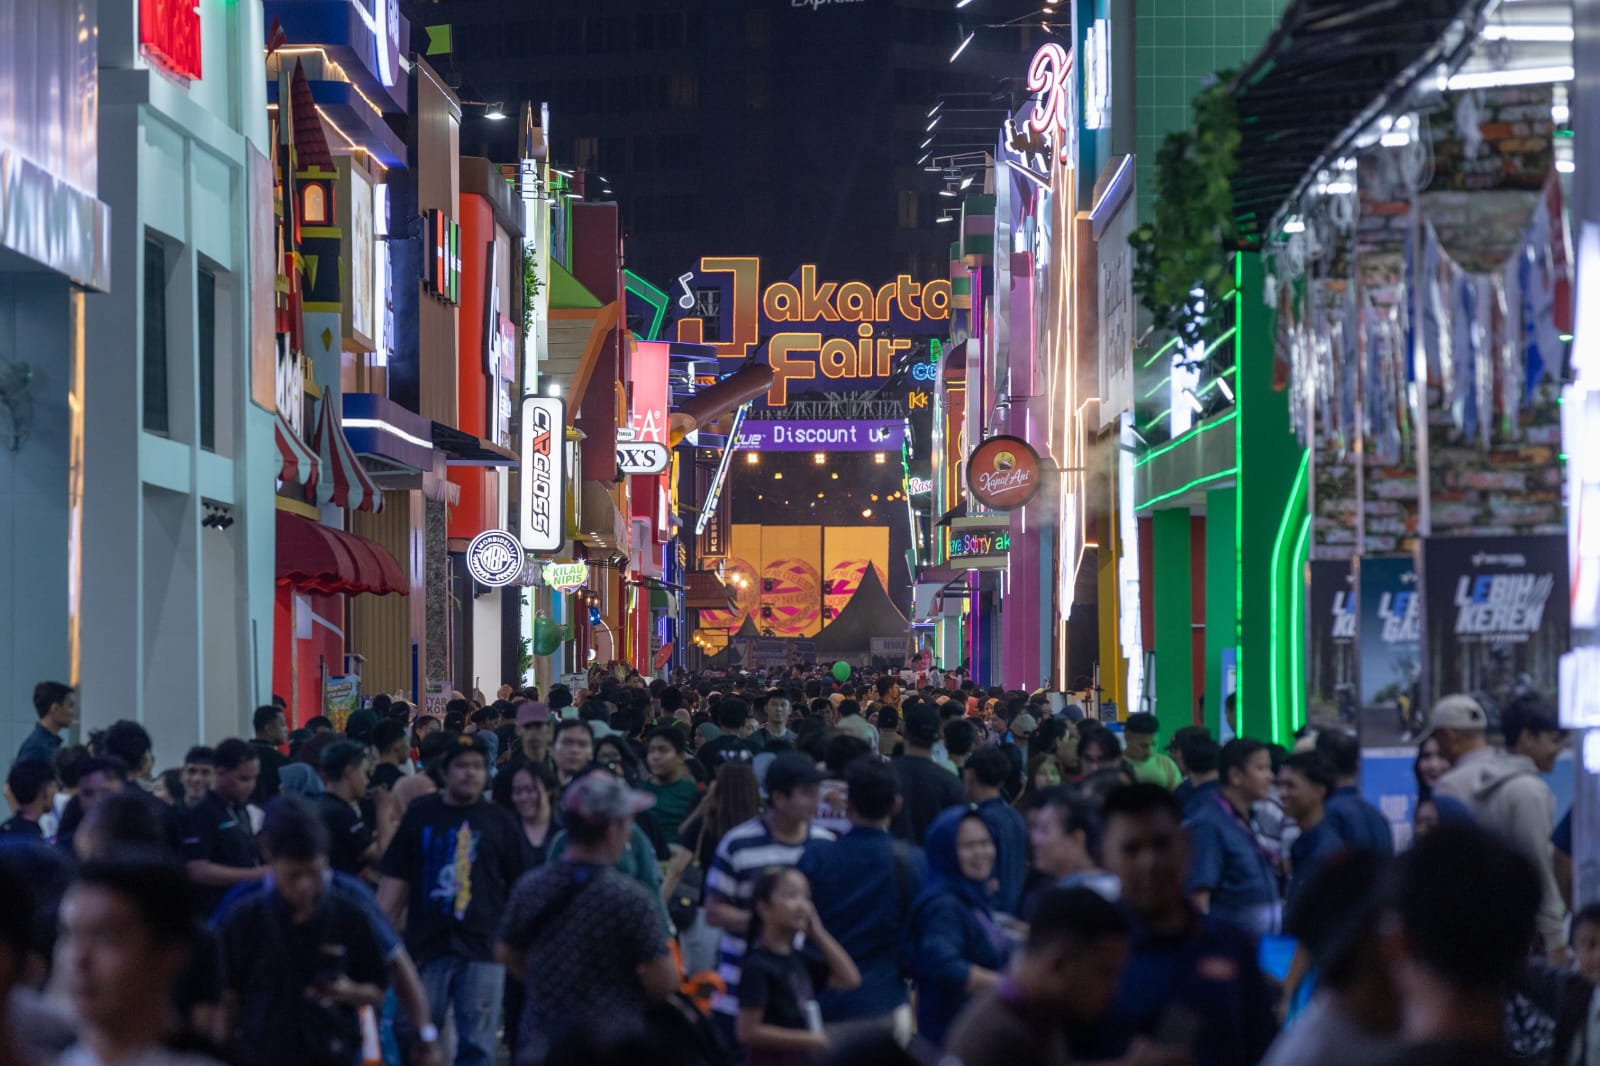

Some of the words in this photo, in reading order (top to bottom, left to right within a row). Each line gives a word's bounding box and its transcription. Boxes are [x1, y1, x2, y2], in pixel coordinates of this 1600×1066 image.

[678, 257, 950, 357] Jakarta
[767, 322, 911, 406] Fair
[773, 425, 857, 443] Discount
[531, 406, 551, 539] CARGLOSS
[553, 565, 584, 577] KILAU
[553, 573, 583, 585] NIPIS
[1454, 604, 1545, 634] KEREN
